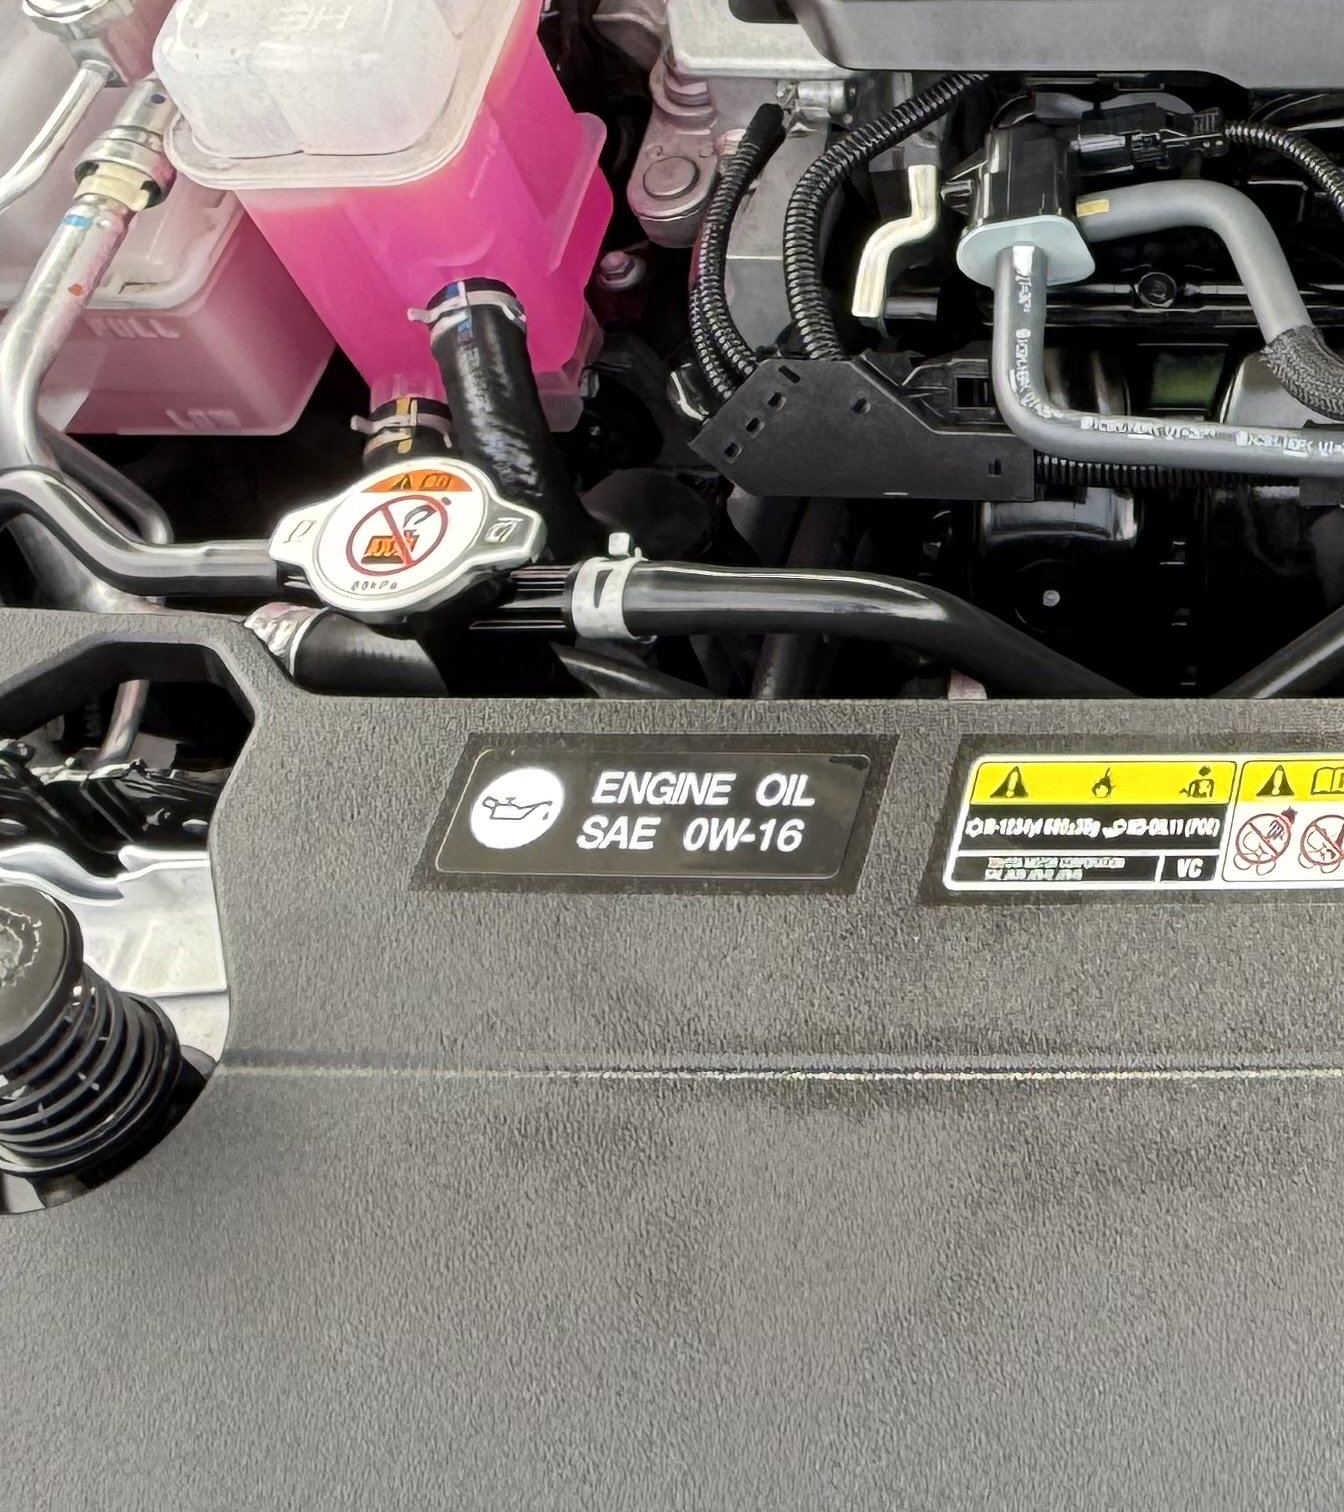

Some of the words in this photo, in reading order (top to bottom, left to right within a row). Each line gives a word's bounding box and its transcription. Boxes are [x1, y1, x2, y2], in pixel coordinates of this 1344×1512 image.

[591, 771, 737, 805] ENGINE
[755, 773, 816, 807] OIL
[576, 815, 662, 850] SAE
[682, 817, 806, 852] 0W-16
[1177, 858, 1203, 879] VC
